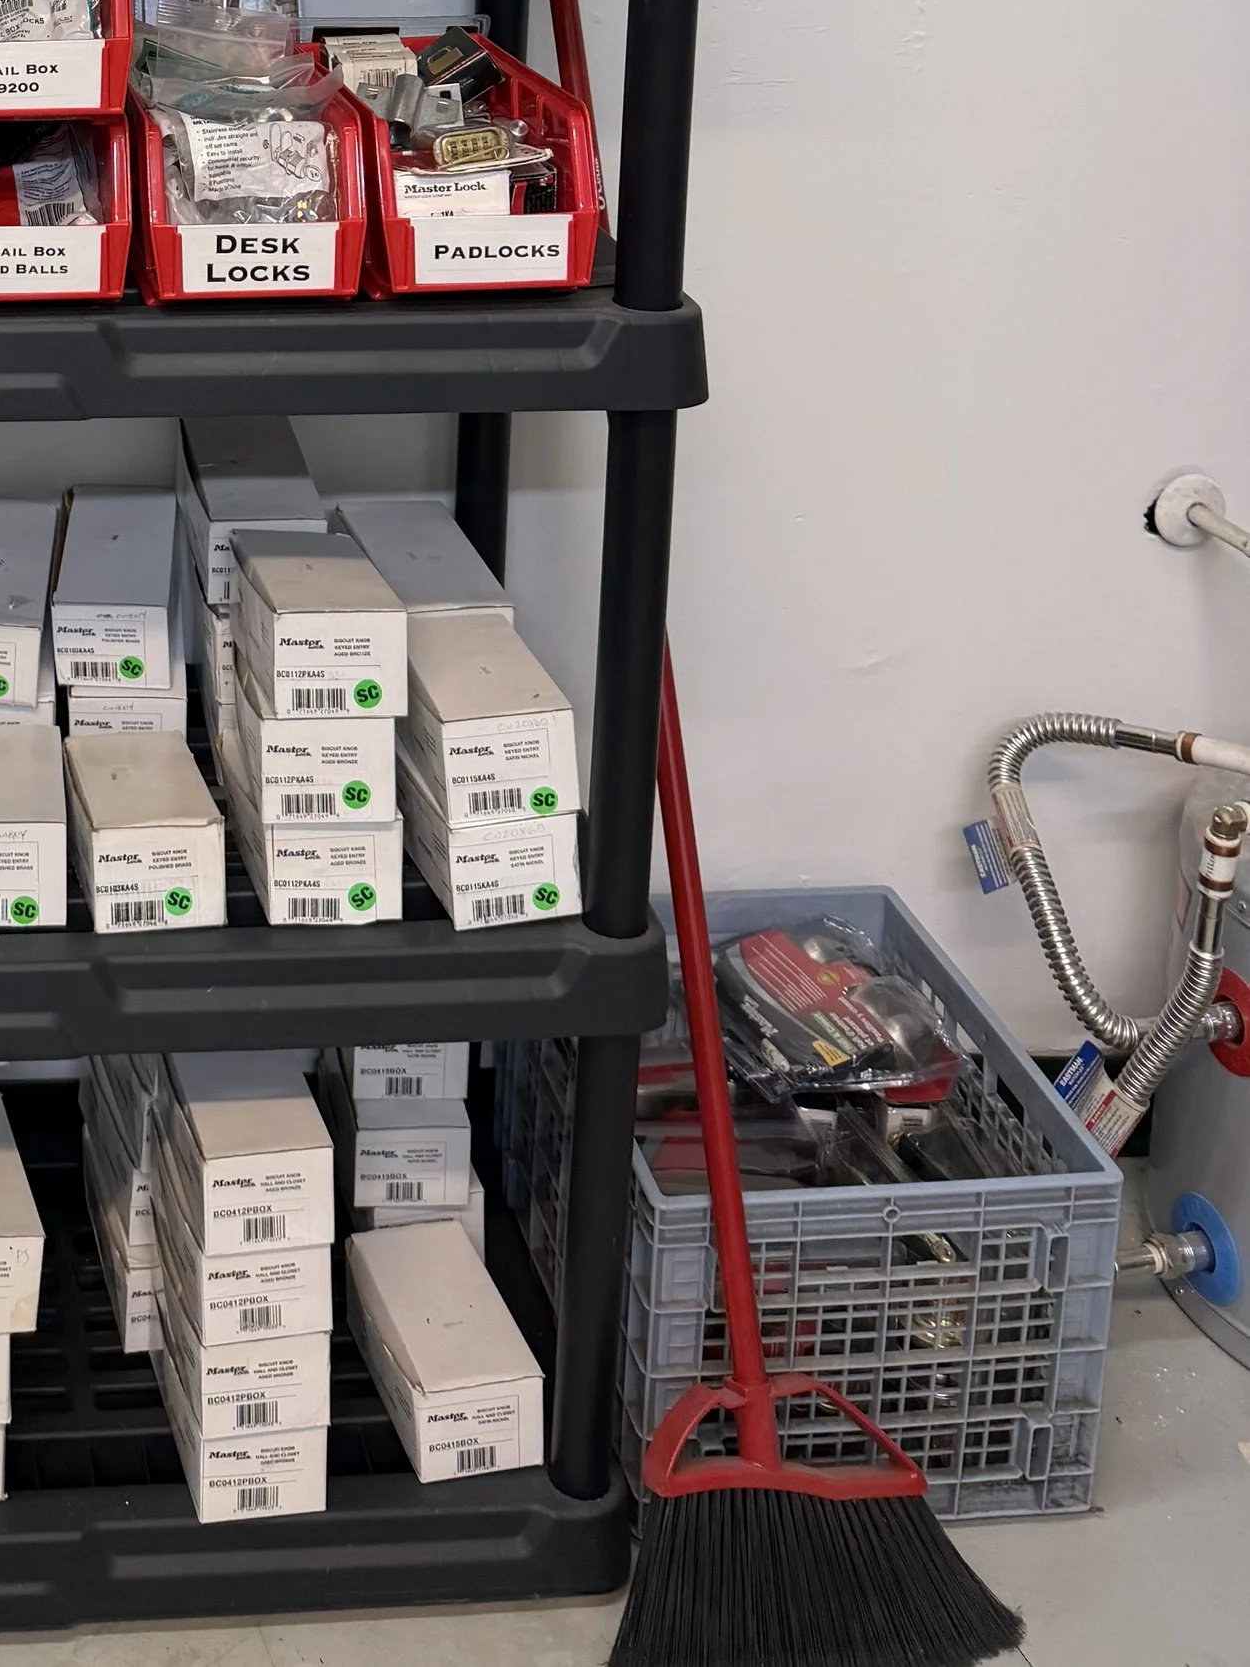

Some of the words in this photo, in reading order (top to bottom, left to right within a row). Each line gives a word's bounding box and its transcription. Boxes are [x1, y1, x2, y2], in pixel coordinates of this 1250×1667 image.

[404, 184, 452, 194] Master
[454, 181, 487, 191] Lock
[121, 659, 142, 676] SC
[277, 670, 325, 678] BC0112PKA4S
[356, 685, 380, 703] SC
[265, 775, 314, 784] BC0112PKA4S
[452, 773, 496, 784] BC0115KA4S
[346, 788, 369, 802] SC
[533, 792, 556, 807] SC
[96, 883, 139, 894] BC0103KA4S
[274, 879, 321, 888] BC0112PKA4S
[456, 881, 499, 891] BC0115KA4S
[166, 891, 191, 912] SC
[351, 886, 374, 907] SC
[536, 888, 558, 906] SC
[14, 903, 37, 917] SC
[360, 1172, 408, 1180] BC0415BOX
[213, 1204, 273, 1217] BC0412PBOX
[210, 1295, 269, 1310] BC0412PBOX
[207, 1391, 266, 1404] BC0412PBOX
[428, 1438, 479, 1452] BC0415BOX
[209, 1476, 268, 1487] BC0412PBOX
